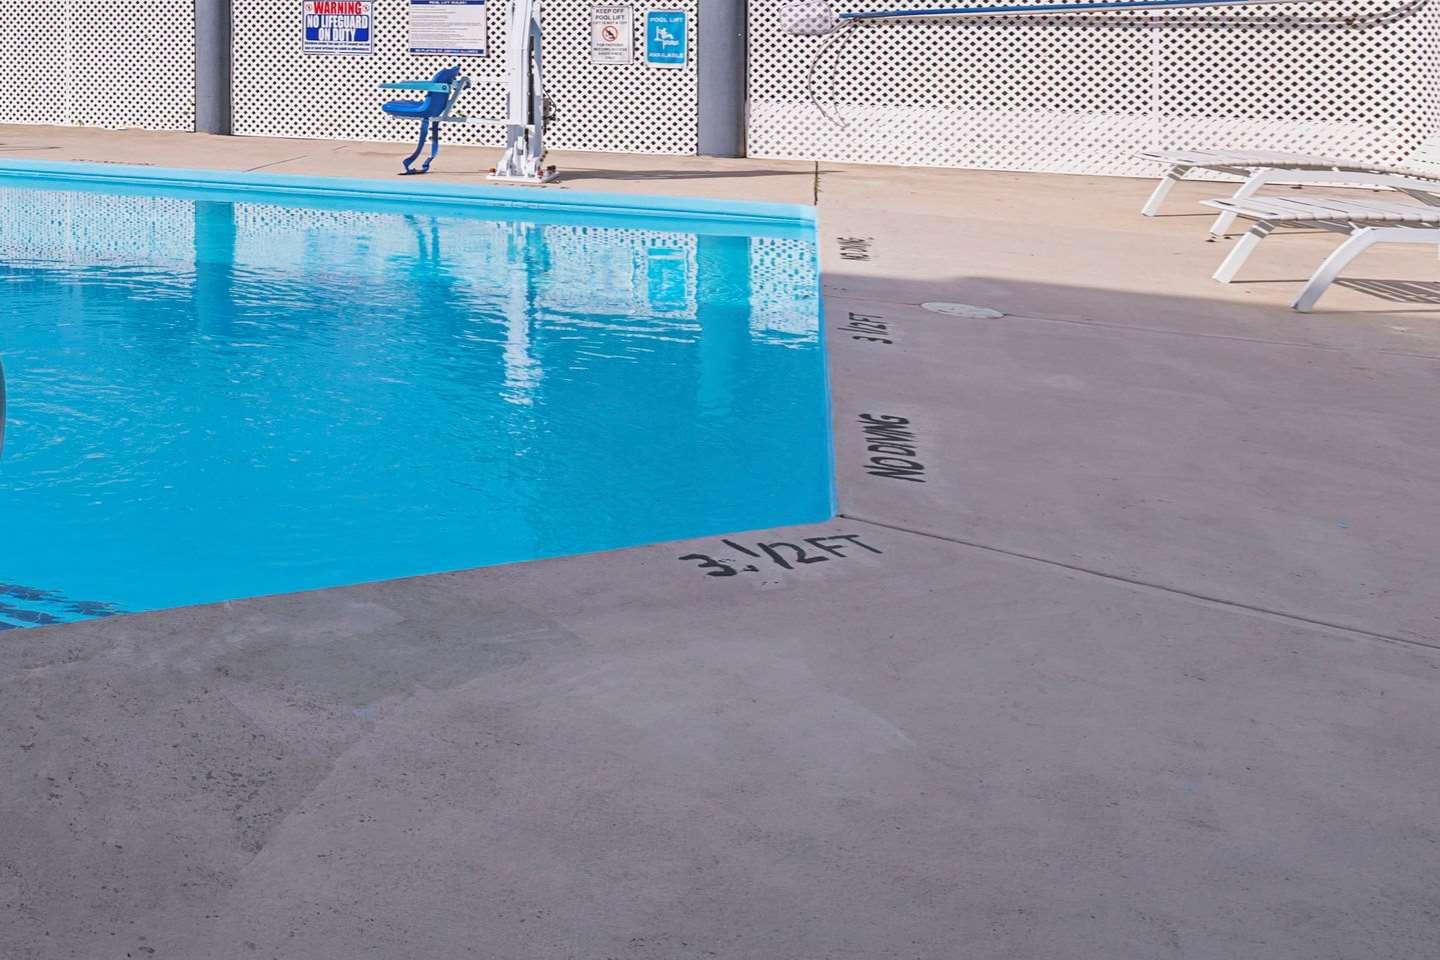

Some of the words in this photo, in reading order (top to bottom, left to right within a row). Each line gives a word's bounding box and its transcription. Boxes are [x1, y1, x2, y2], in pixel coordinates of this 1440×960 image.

[313, 1, 362, 14] WARNING
[307, 15, 320, 28] NO
[321, 15, 368, 28] LIFEGUARD
[318, 28, 331, 41] ON
[332, 28, 356, 41] DUTY
